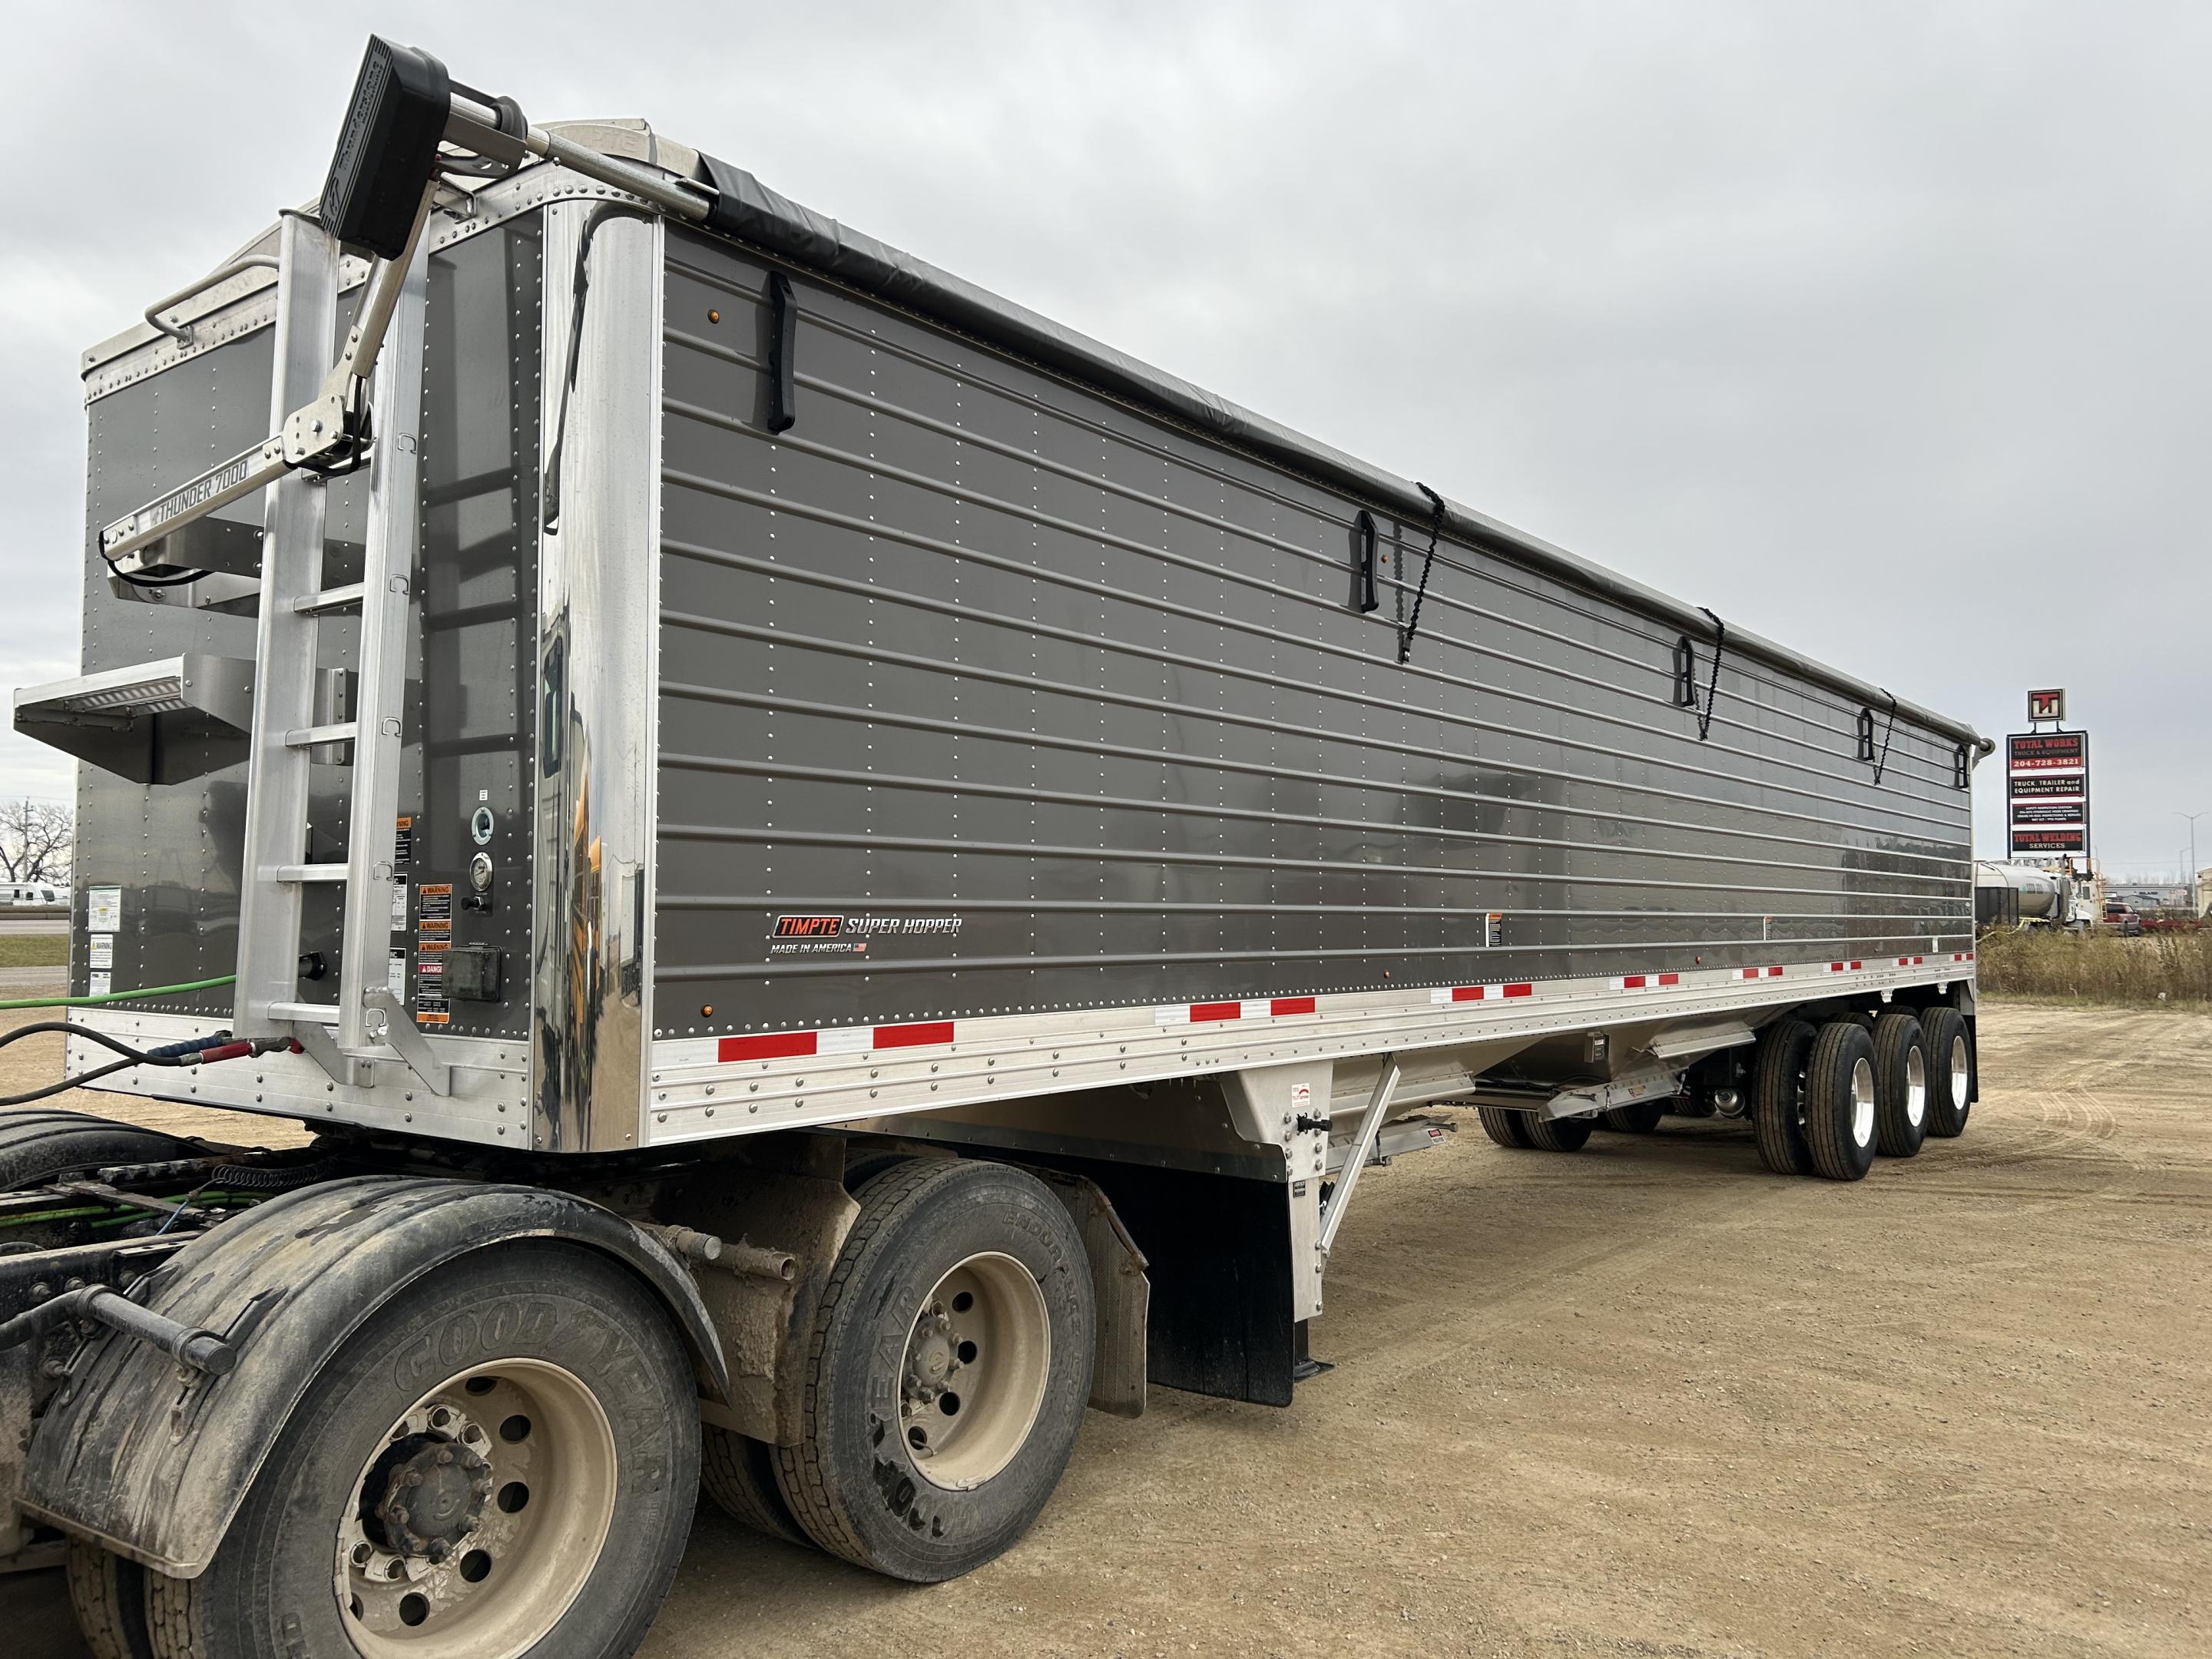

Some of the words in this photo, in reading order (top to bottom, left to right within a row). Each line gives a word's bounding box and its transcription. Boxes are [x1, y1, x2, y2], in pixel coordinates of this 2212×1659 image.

[338, 60, 380, 171] Thunderstone
[160, 478, 212, 522] THUNDER
[215, 459, 248, 493] 7000
[2014, 739, 2043, 750] TOTAL
[2045, 737, 2078, 748] WORKS
[2014, 758, 2079, 767] 204-728-3821
[2015, 833, 2041, 843] TOTAL
[2041, 832, 2082, 842] WELDING
[780, 916, 841, 935] TIMPTE
[845, 917, 900, 935] SUPER
[902, 917, 962, 934] HOPPER
[770, 943, 797, 954] MADE
[800, 943, 810, 953] IN
[811, 942, 852, 954] AMERICA
[394, 1301, 668, 1495] GOODYEAR
